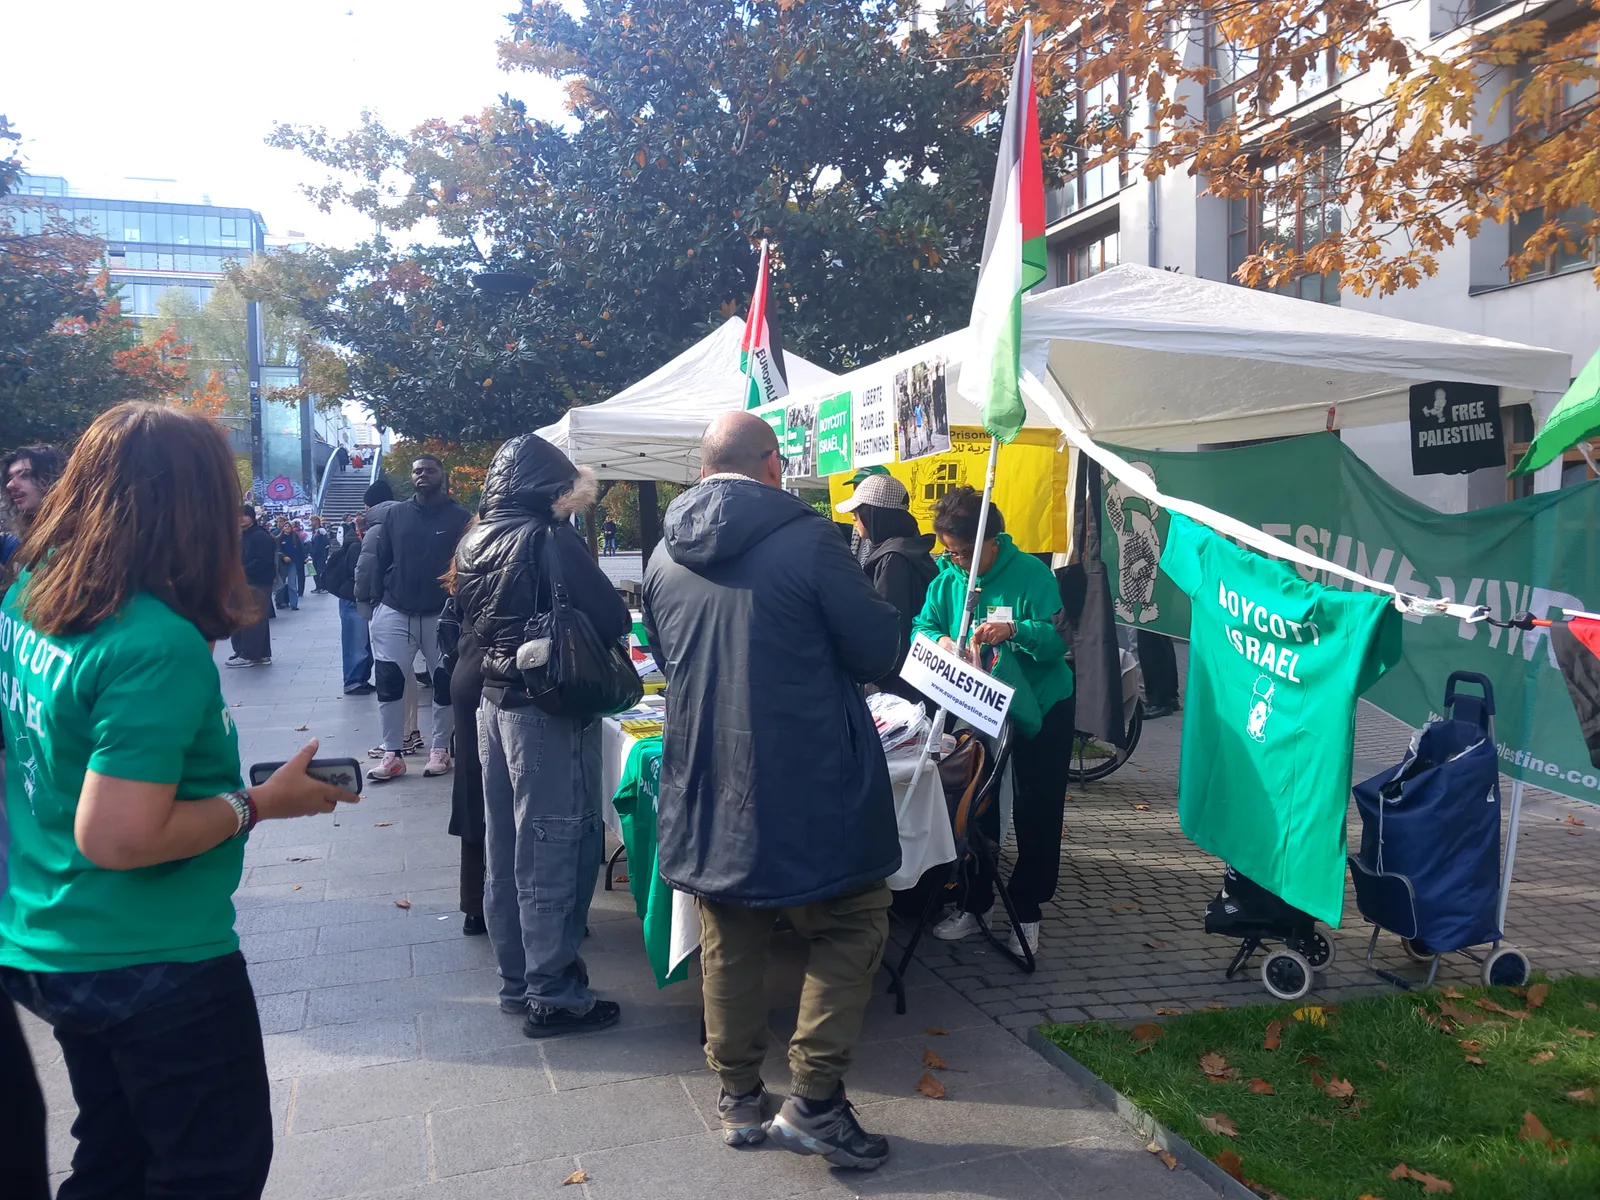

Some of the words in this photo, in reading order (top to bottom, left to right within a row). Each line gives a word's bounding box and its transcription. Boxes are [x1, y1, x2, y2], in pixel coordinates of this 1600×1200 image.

[819, 411, 847, 433] BOYCOTT
[861, 413, 875, 432] POUR
[875, 410, 885, 428] LES
[1452, 401, 1486, 422] FREE
[855, 434, 890, 456] PALESTINIENS
[1418, 422, 1495, 448] PALESTINE
[1219, 580, 1319, 646] BOYCOTT
[1225, 625, 1300, 683] ISRAEL
[912, 642, 1007, 712] EUROPALESTINE
[931, 681, 998, 726] www.europalestine.com
